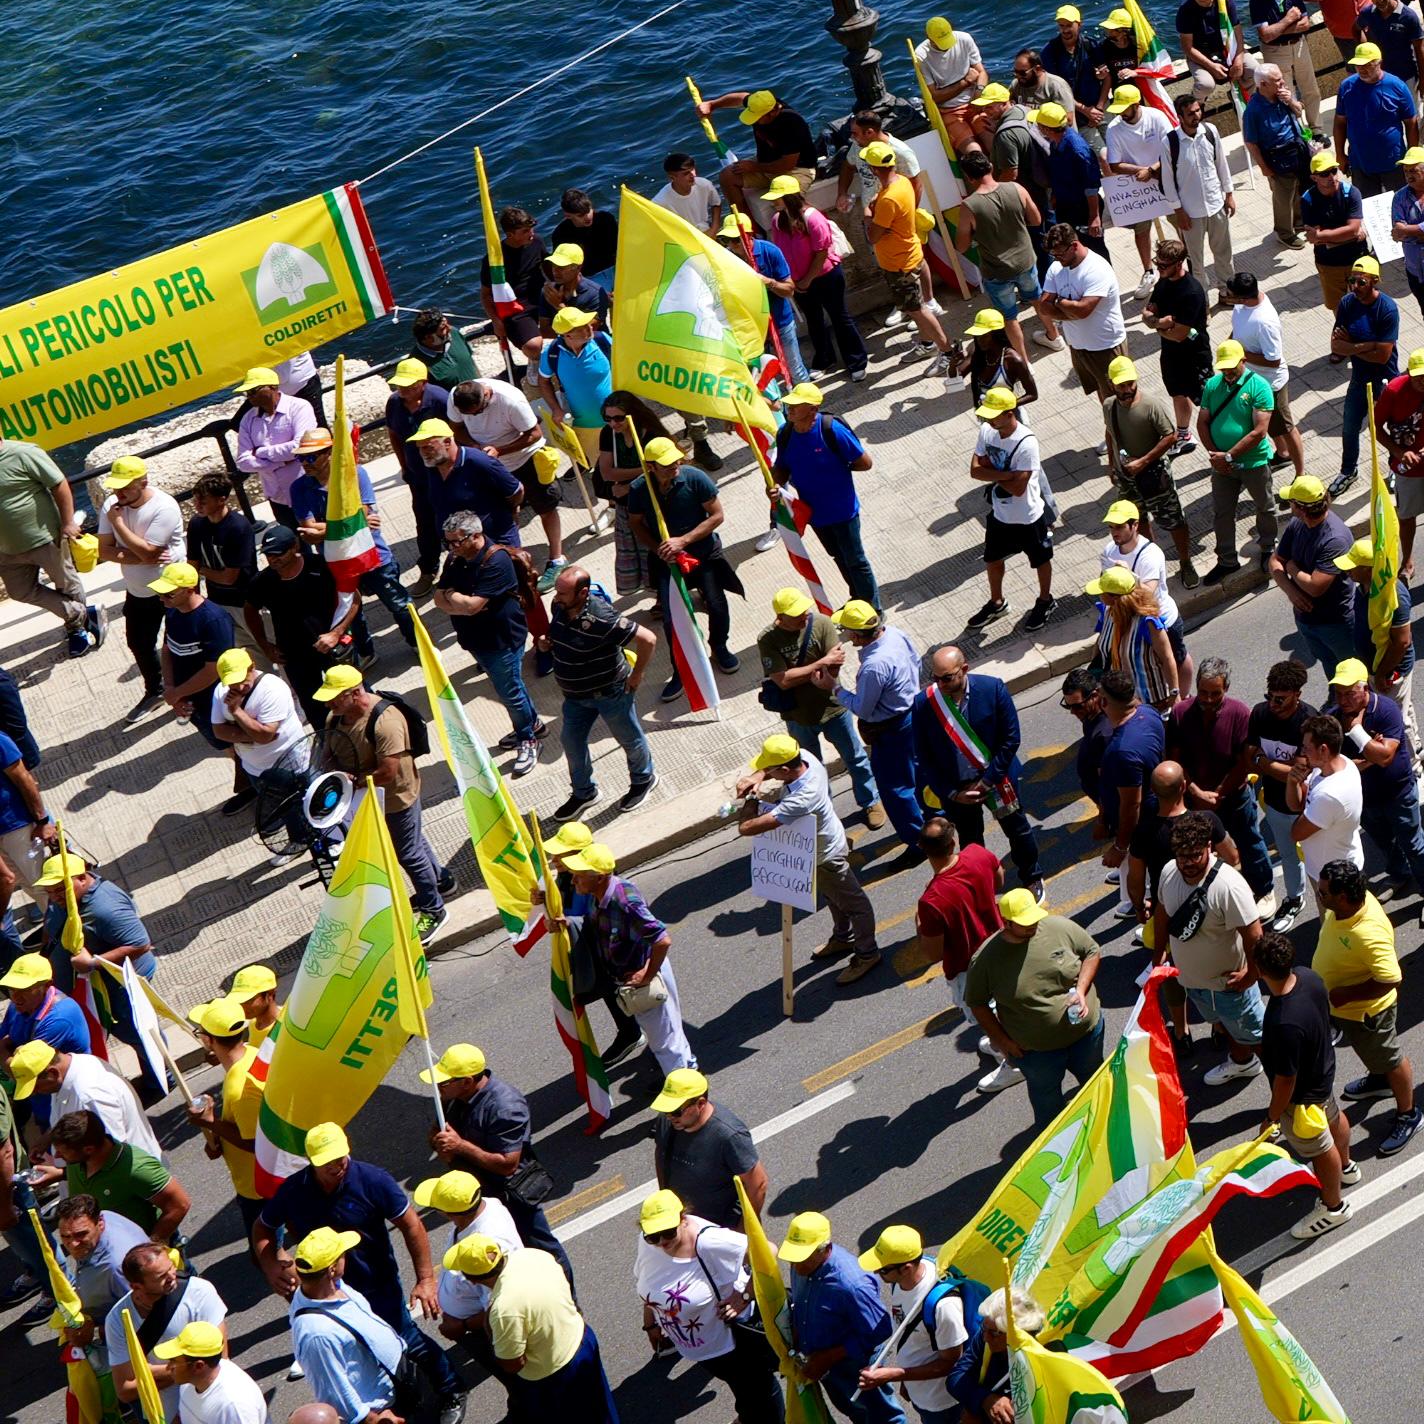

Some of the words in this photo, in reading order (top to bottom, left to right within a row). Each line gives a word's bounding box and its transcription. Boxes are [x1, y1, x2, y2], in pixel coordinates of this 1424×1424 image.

[1109, 184, 1160, 204] INVASION
[1113, 196, 1167, 215] CINGHIAL
[23, 286, 155, 367] PERICOLO
[154, 266, 215, 318] PER
[263, 300, 348, 347] COLDIRETTI
[0, 339, 203, 442] AUTOMOBILISTI
